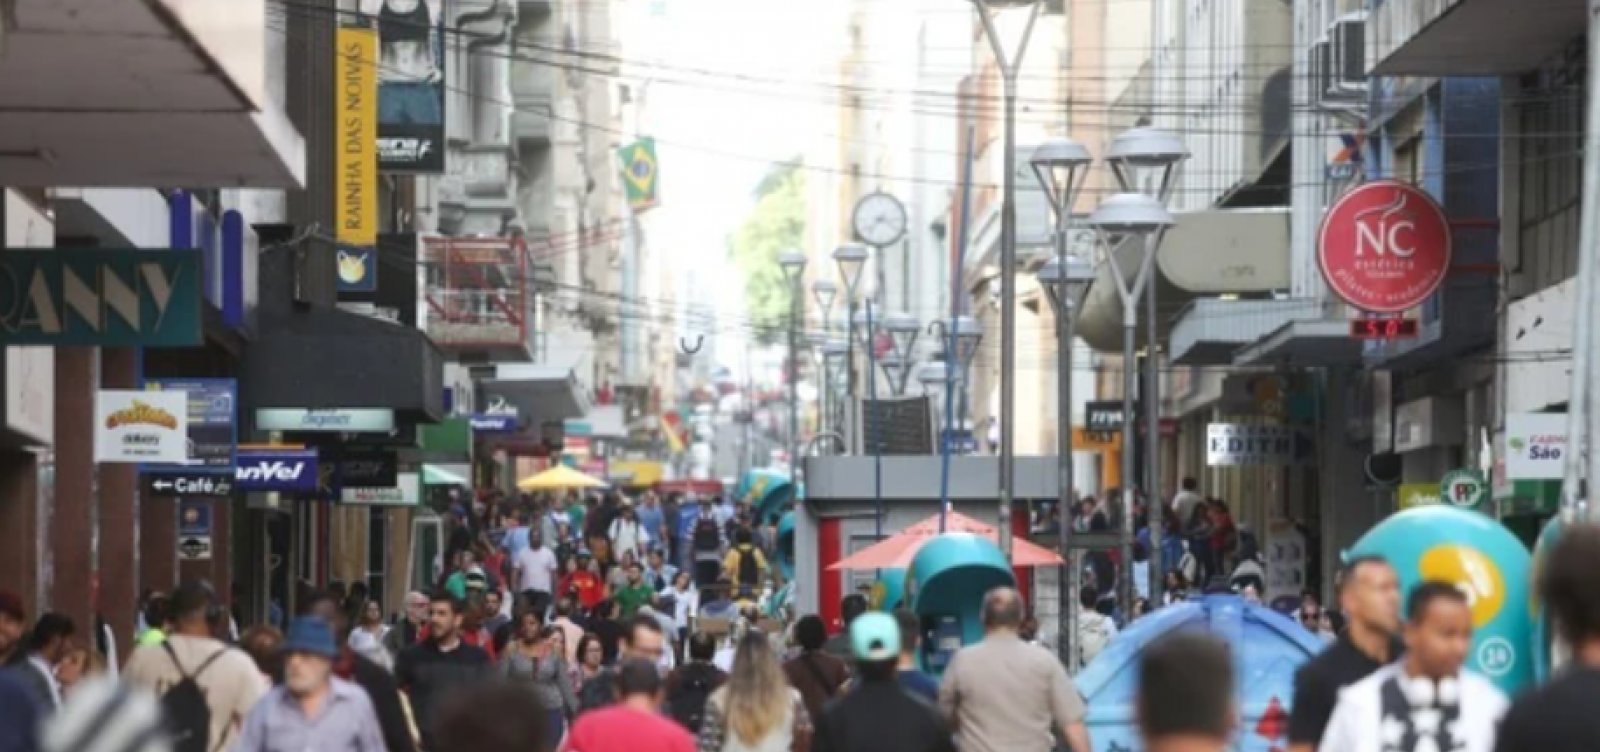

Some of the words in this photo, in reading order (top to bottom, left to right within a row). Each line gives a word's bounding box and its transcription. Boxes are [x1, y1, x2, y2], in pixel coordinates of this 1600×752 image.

[345, 42, 362, 110] NOIVAS
[345, 117, 362, 154] DAS
[345, 161, 362, 229] RAINHA
[1355, 220, 1416, 258] NC
[1210, 436, 1291, 454] EDITH
[1529, 444, 1562, 461] São
[174, 477, 214, 494] Café
